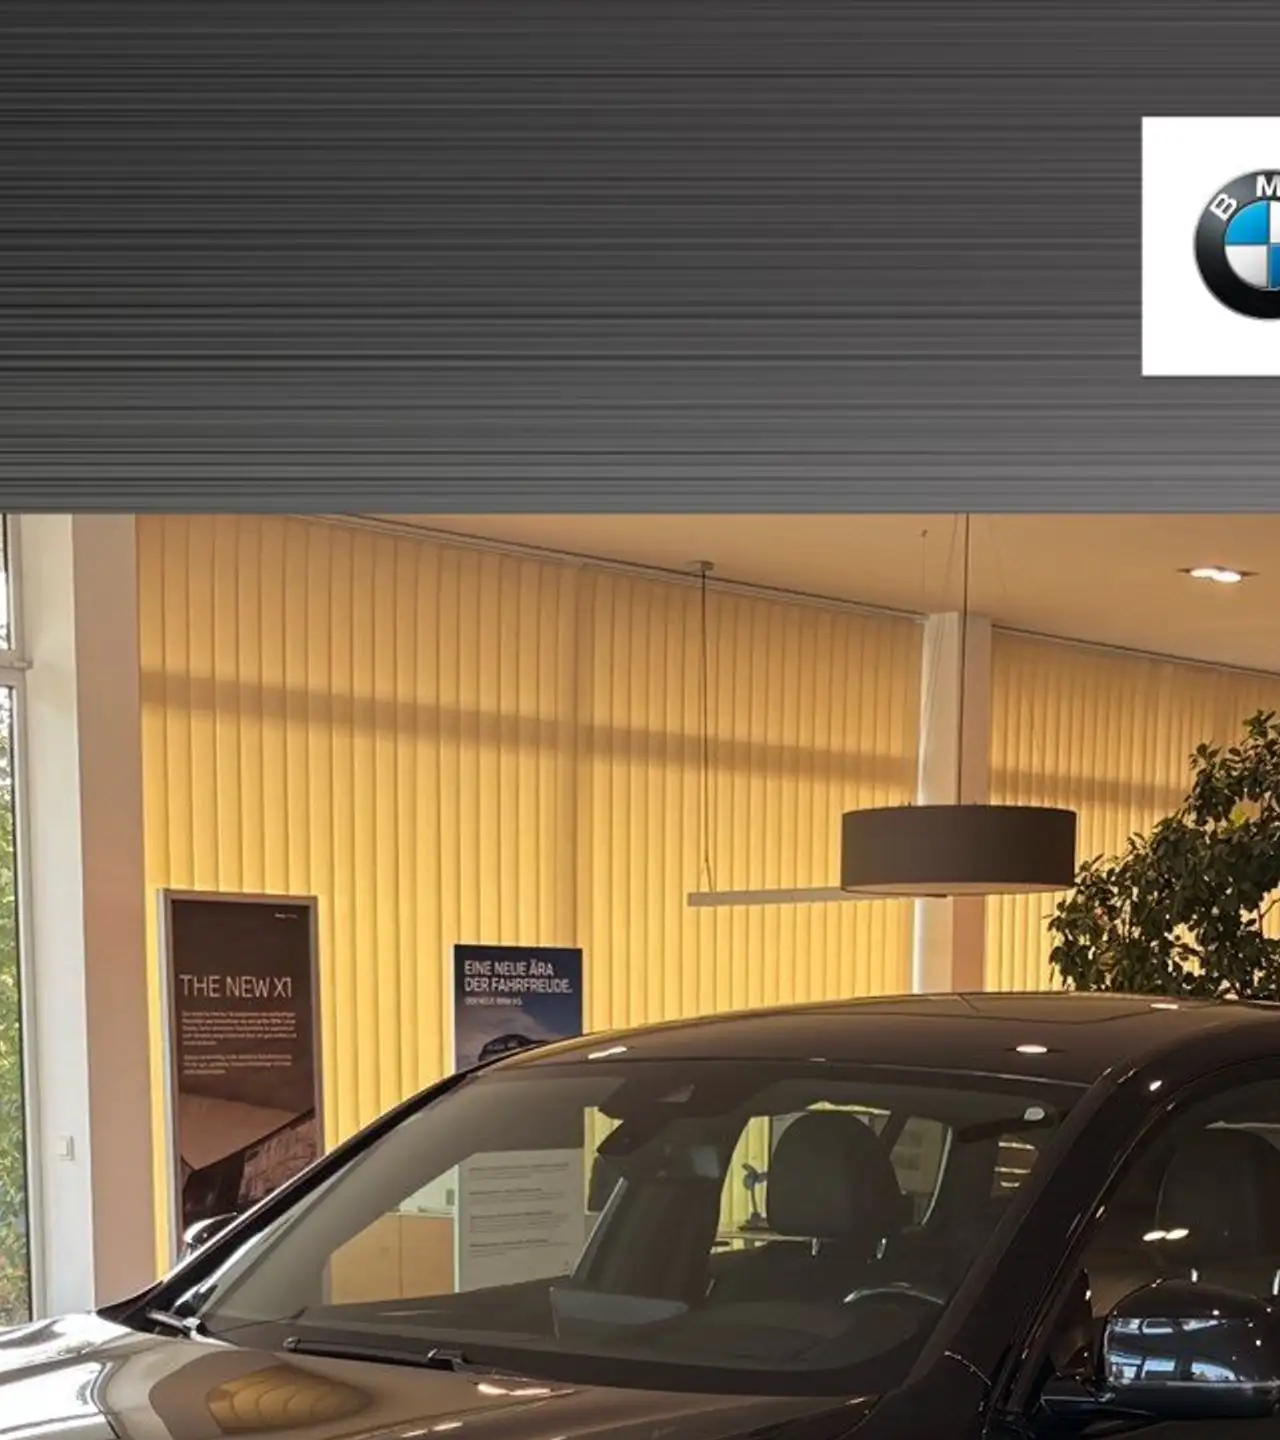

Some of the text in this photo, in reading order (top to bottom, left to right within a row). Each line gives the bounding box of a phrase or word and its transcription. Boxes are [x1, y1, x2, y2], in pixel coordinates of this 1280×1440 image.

[463, 957, 555, 977] EINE NEUE ÄRA
[179, 974, 293, 998] THE NEW X1
[463, 977, 490, 992] DER
